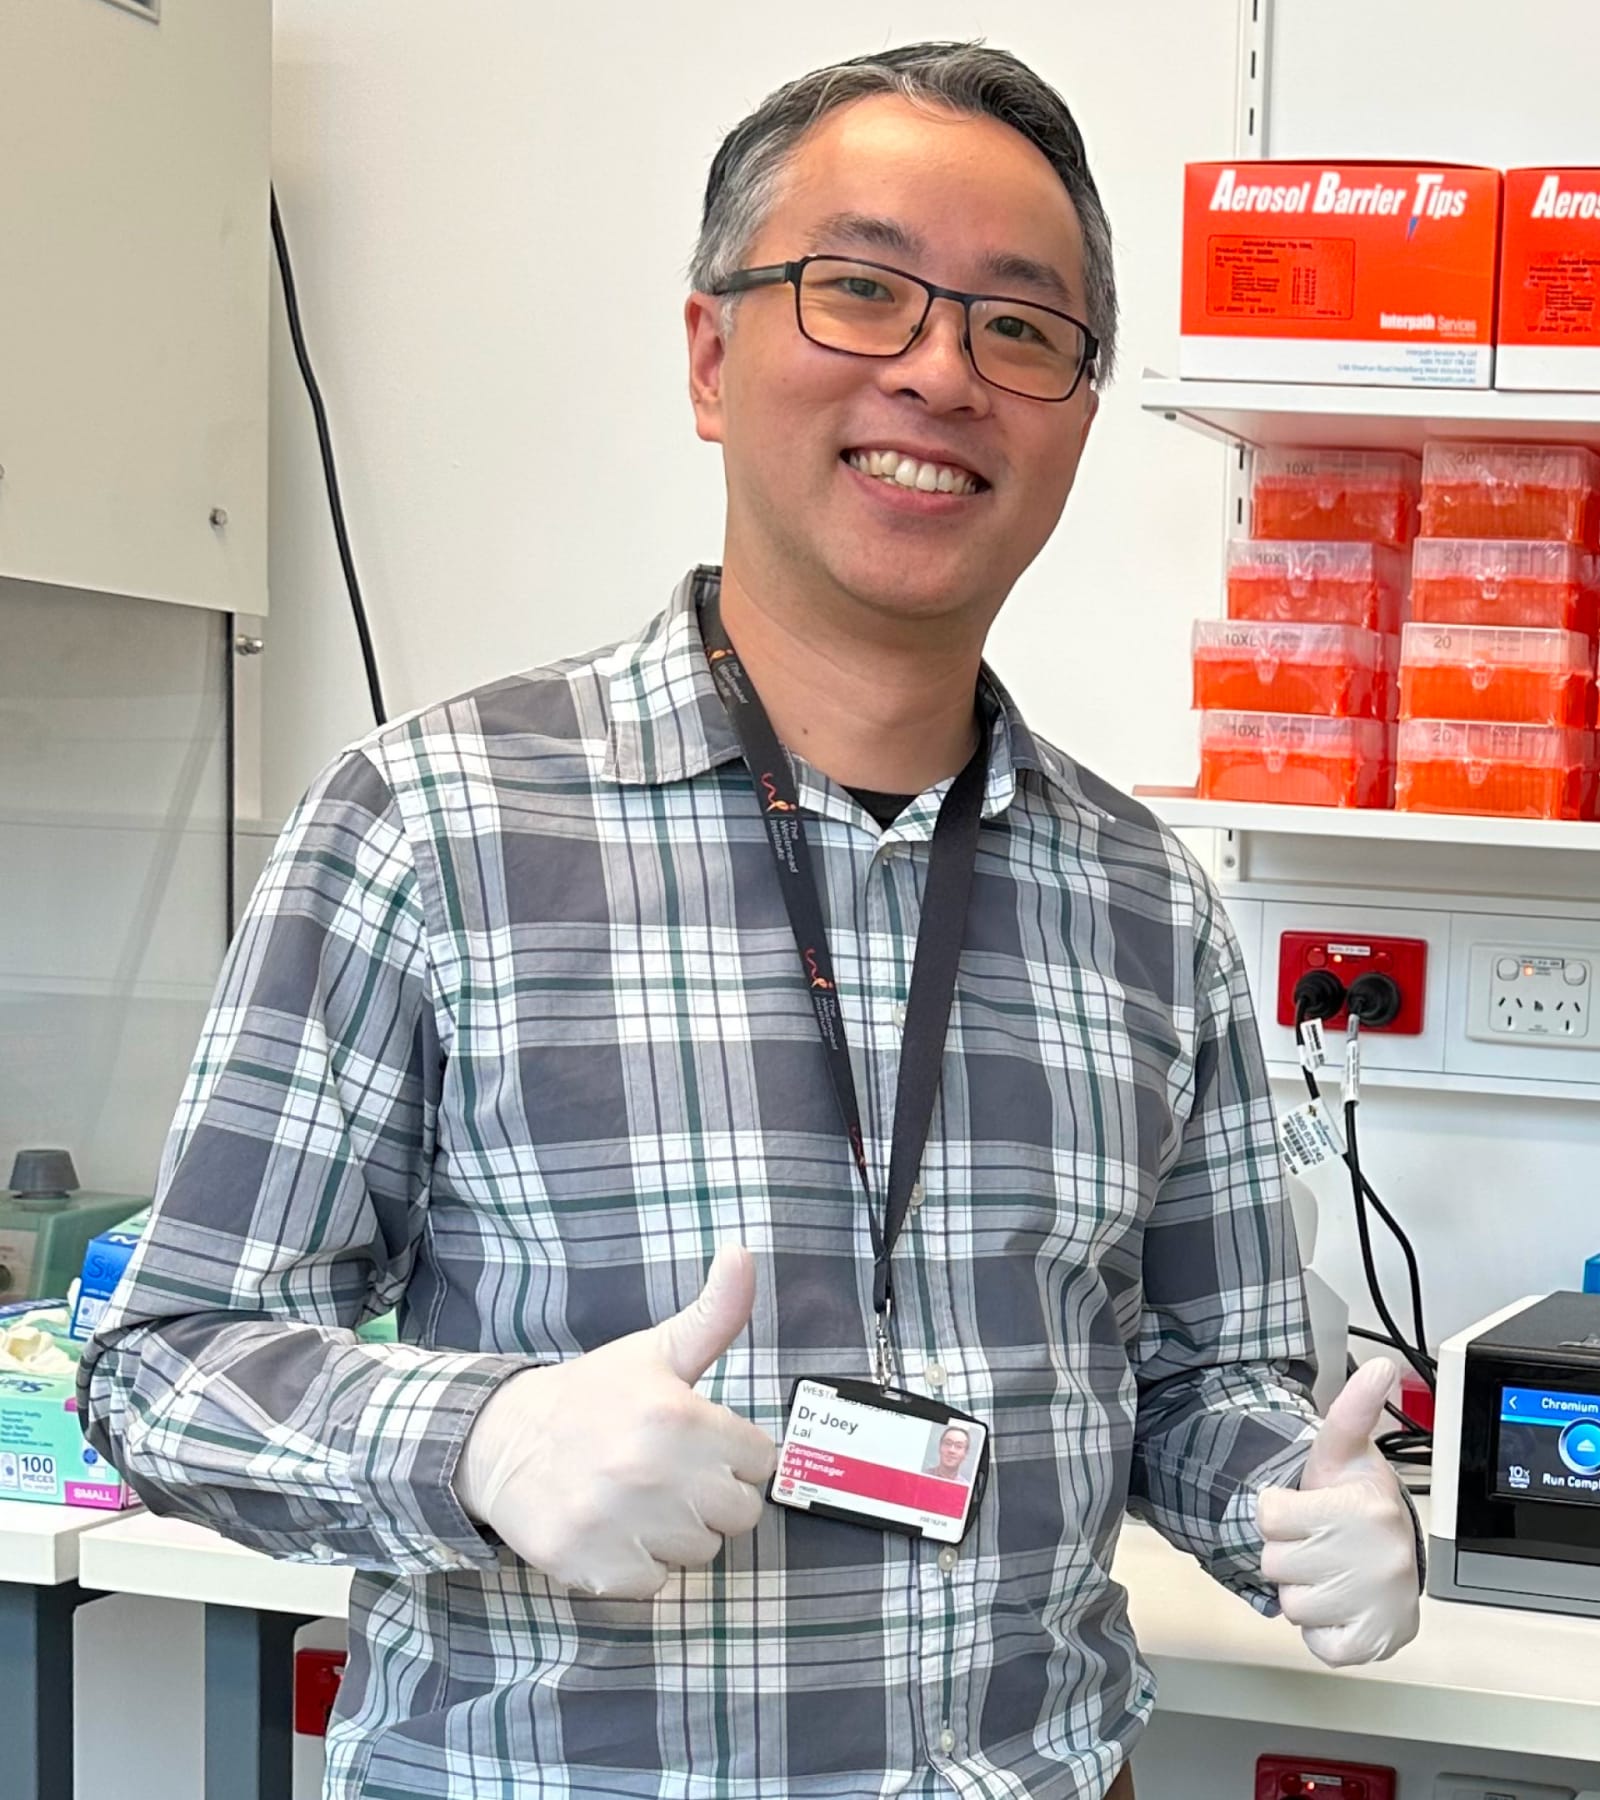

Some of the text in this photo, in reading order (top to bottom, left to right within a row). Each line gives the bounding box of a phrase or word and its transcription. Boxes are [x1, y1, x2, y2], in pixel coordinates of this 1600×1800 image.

[1209, 169, 1467, 219] Aerosol Barrier Tips
[1380, 312, 1477, 332] Interpath Services
[1286, 463, 1315, 476] 10XL
[1225, 633, 1257, 647] 10XL
[1433, 635, 1452, 649] 20
[1231, 725, 1264, 738] 10XL
[1433, 729, 1451, 742] 20
[1541, 1397, 1599, 1413] Chromium
[798, 1406, 859, 1436] Dr Joey
[792, 1425, 811, 1438] Lai
[21, 1456, 54, 1474] 100
[784, 1454, 845, 1477] Lab Manager
[22, 1474, 54, 1483] PIECES
[1508, 1466, 1530, 1479] 10x
[1542, 1473, 1565, 1488] Run
[73, 1488, 113, 1501] SMALL
